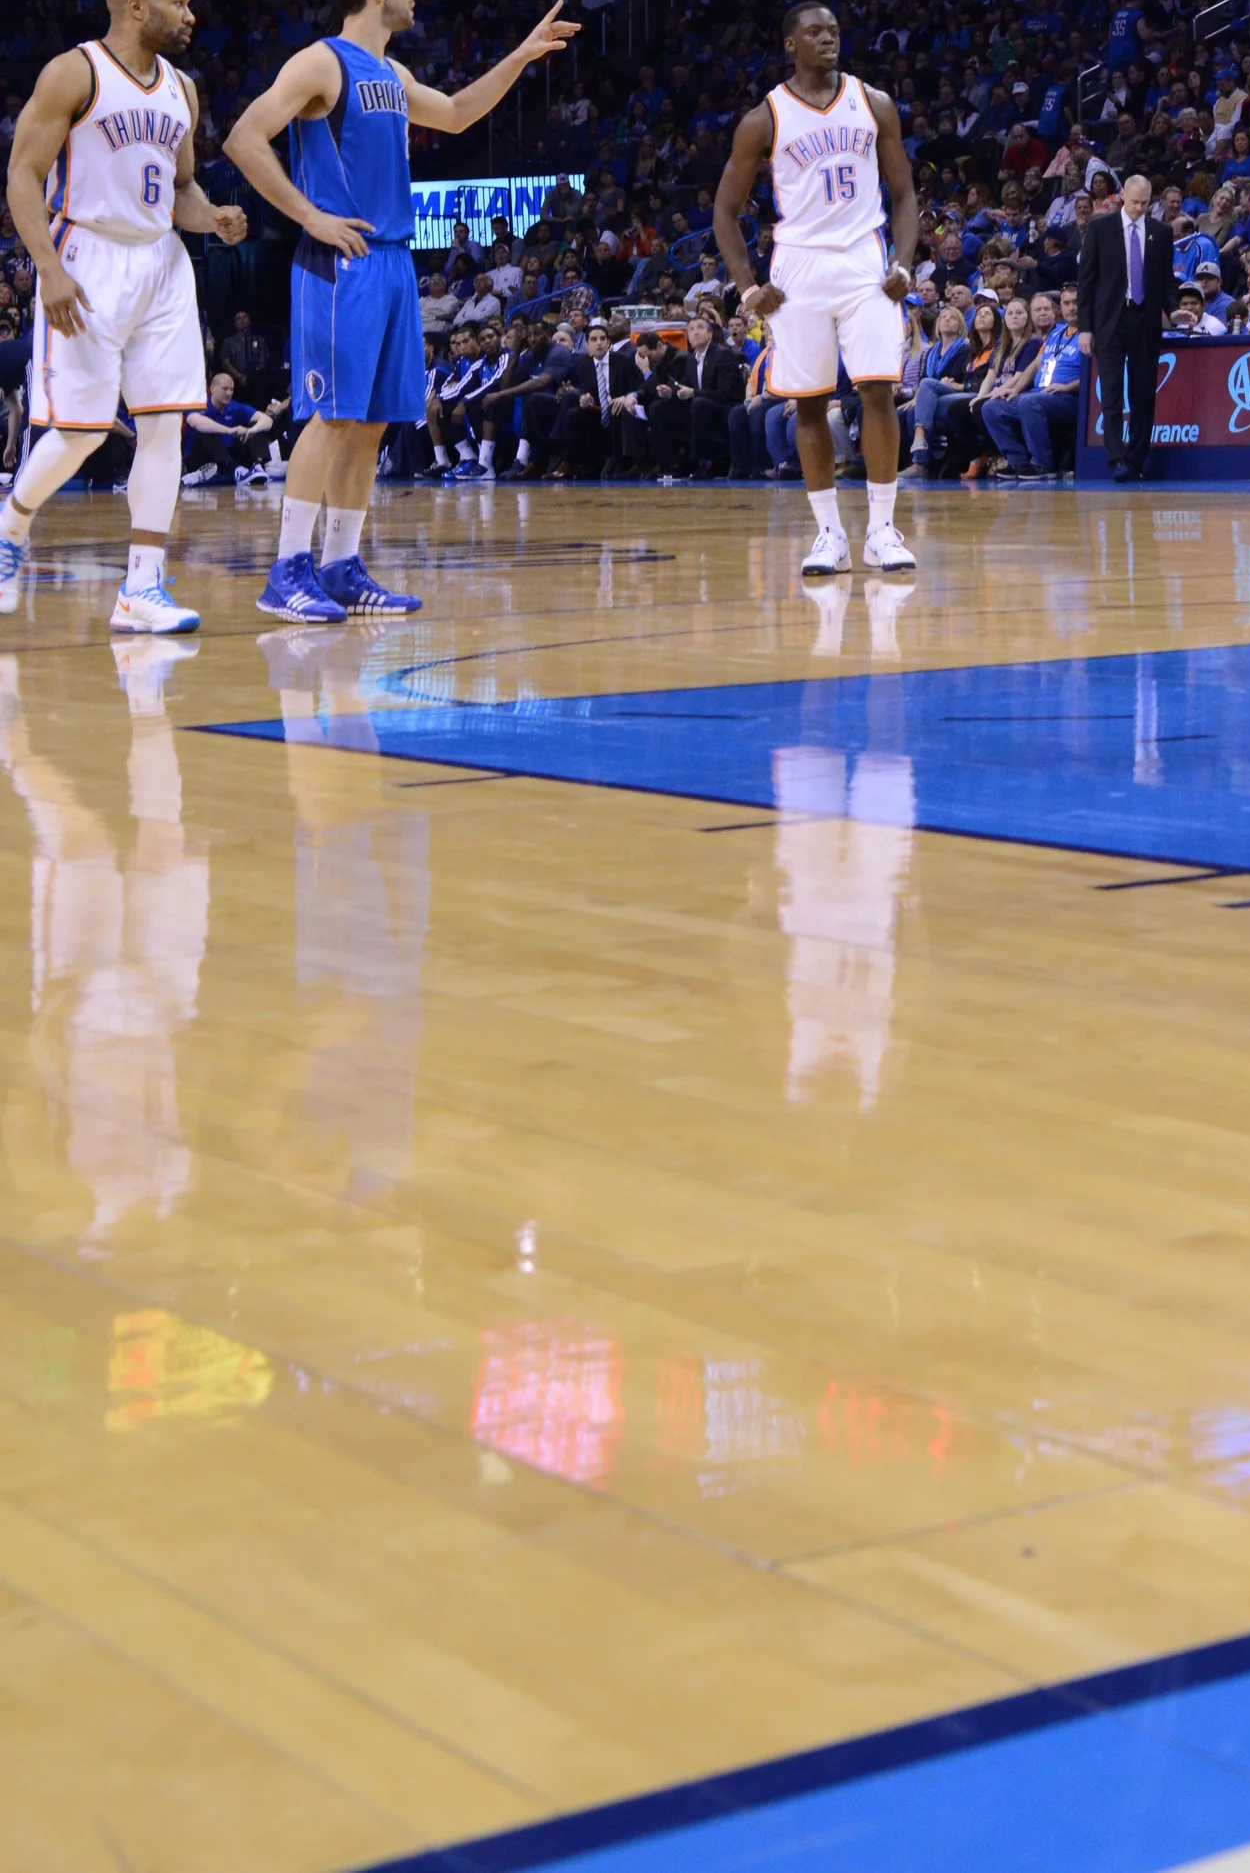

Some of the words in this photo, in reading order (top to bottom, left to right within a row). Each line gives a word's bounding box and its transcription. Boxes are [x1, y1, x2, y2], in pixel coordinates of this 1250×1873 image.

[97, 108, 188, 153] THUNDE
[781, 125, 875, 172] THUNDER
[141, 162, 162, 207] 6
[817, 163, 857, 206] 15
